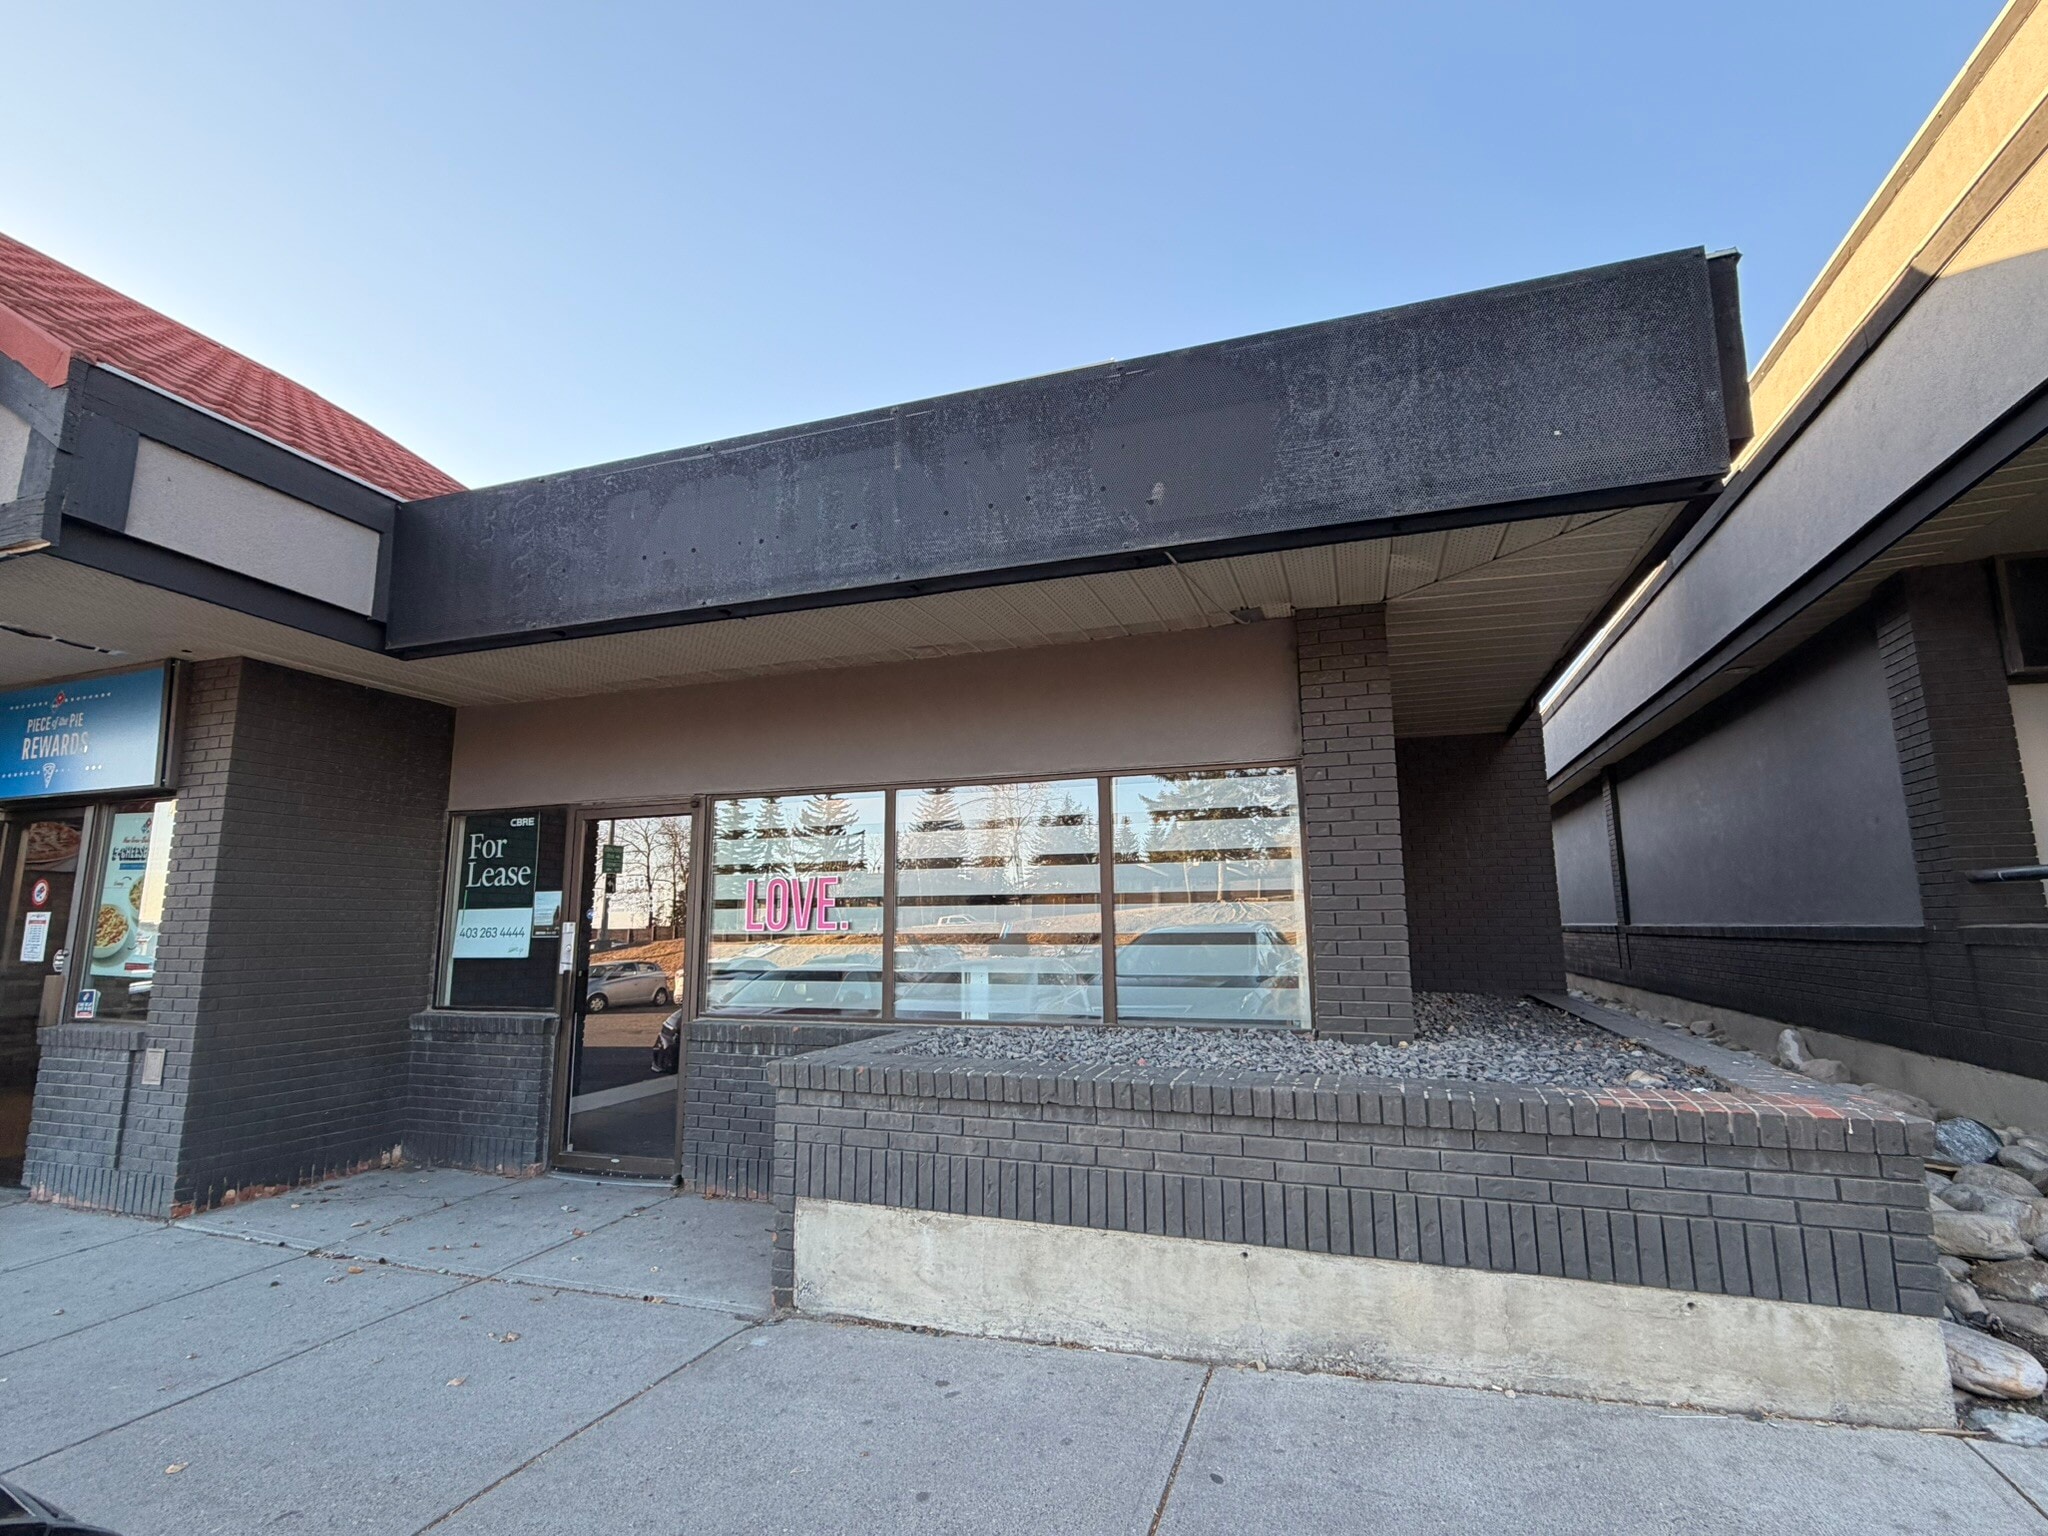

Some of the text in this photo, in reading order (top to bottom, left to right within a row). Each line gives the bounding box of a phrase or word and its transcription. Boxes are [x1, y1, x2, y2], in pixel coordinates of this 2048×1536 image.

[26, 712, 84, 733] PIECE of the PIE
[21, 731, 89, 760] REWARDS
[510, 817, 535, 827] CBRE
[468, 833, 508, 860] For
[465, 861, 531, 888] Lease
[745, 876, 850, 932] LOVE.
[459, 927, 478, 939] 403
[479, 926, 498, 939] 263
[499, 926, 525, 939] 4444
